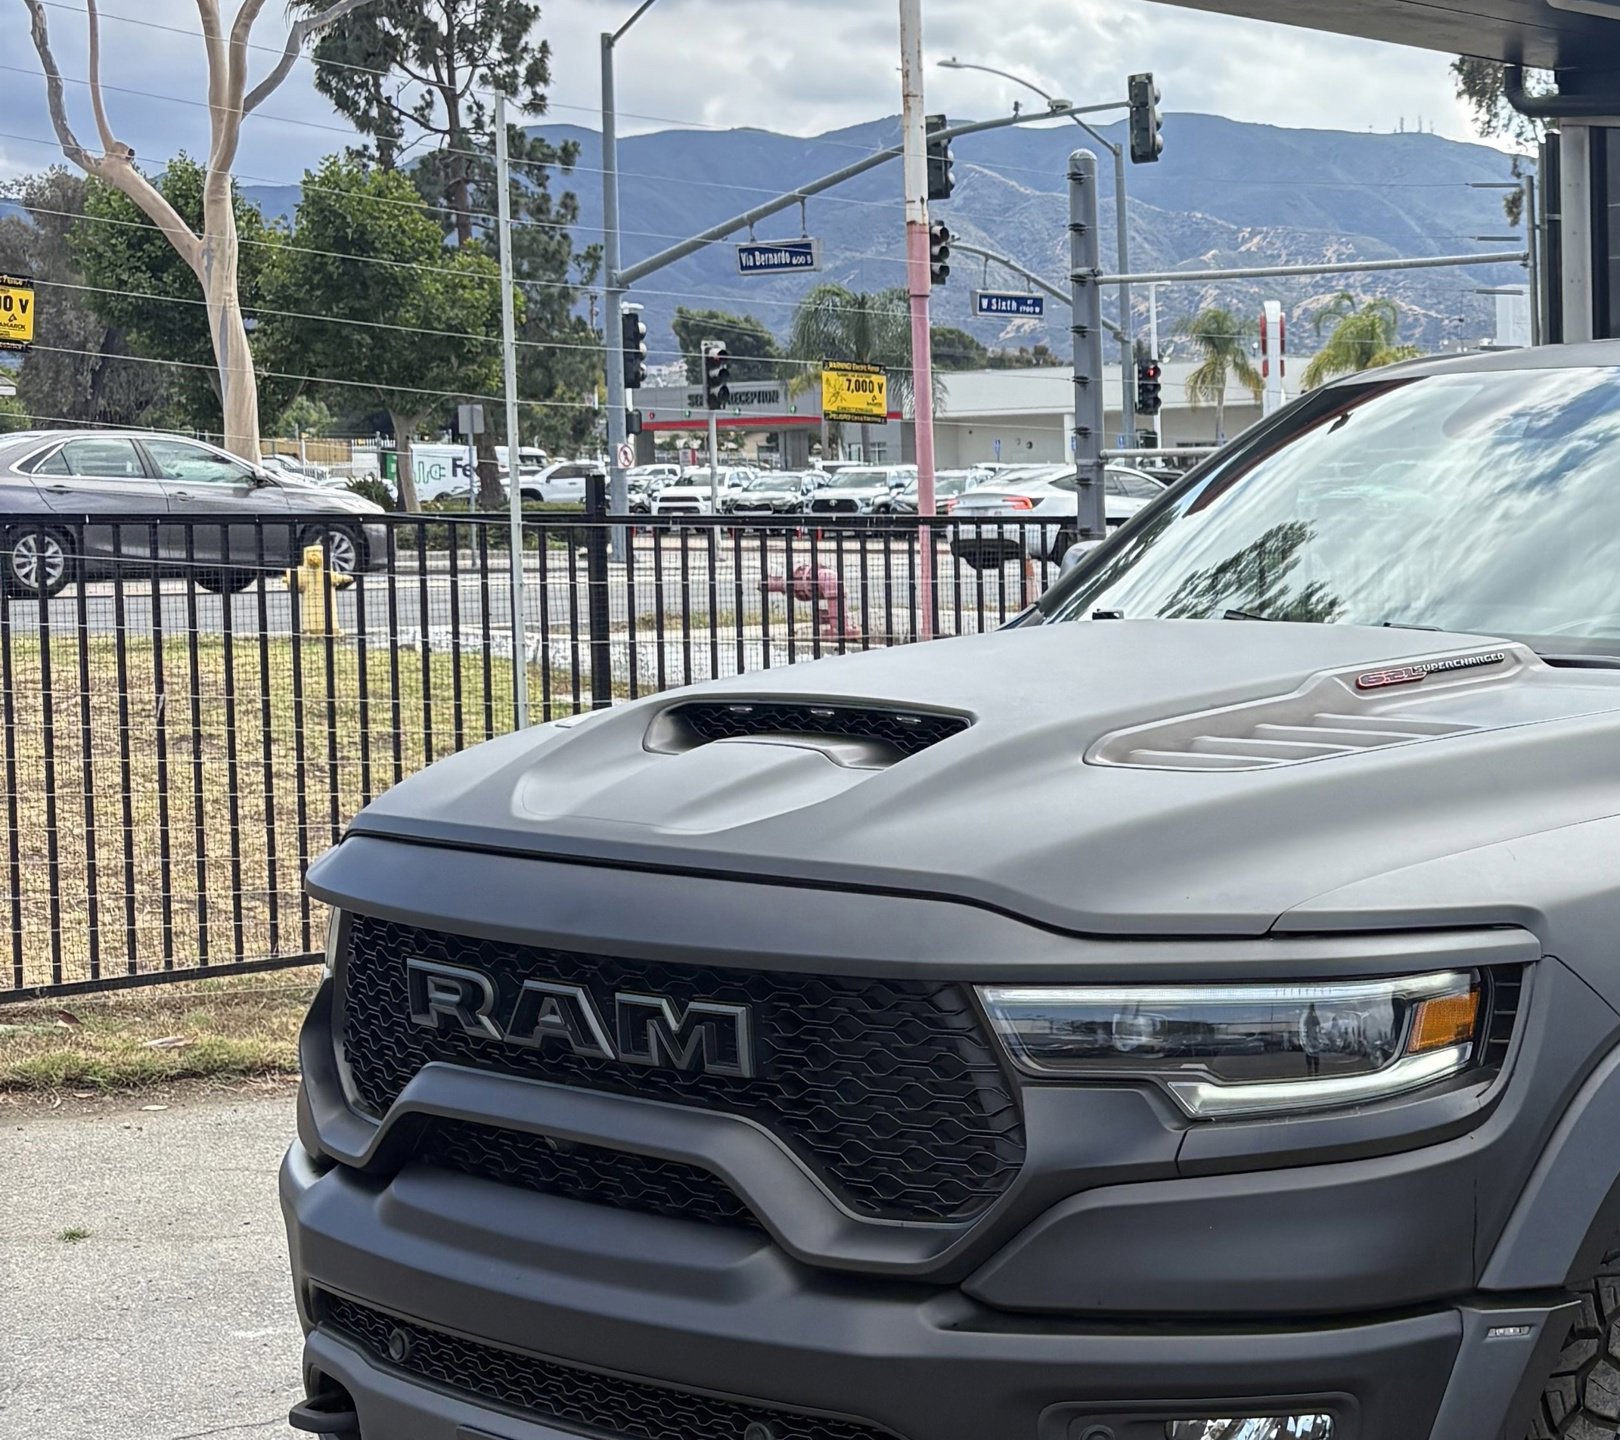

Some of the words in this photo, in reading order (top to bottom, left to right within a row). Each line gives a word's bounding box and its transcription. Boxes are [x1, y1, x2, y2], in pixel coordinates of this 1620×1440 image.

[740, 251, 754, 267] Via
[754, 250, 791, 266] Bernardo
[19, 298, 30, 315] V
[991, 297, 1018, 312] Sixth
[845, 378, 875, 394] 7,000
[877, 382, 884, 395] V
[1411, 652, 1505, 673] SUPERCHARGED
[406, 958, 754, 1078] RAM
